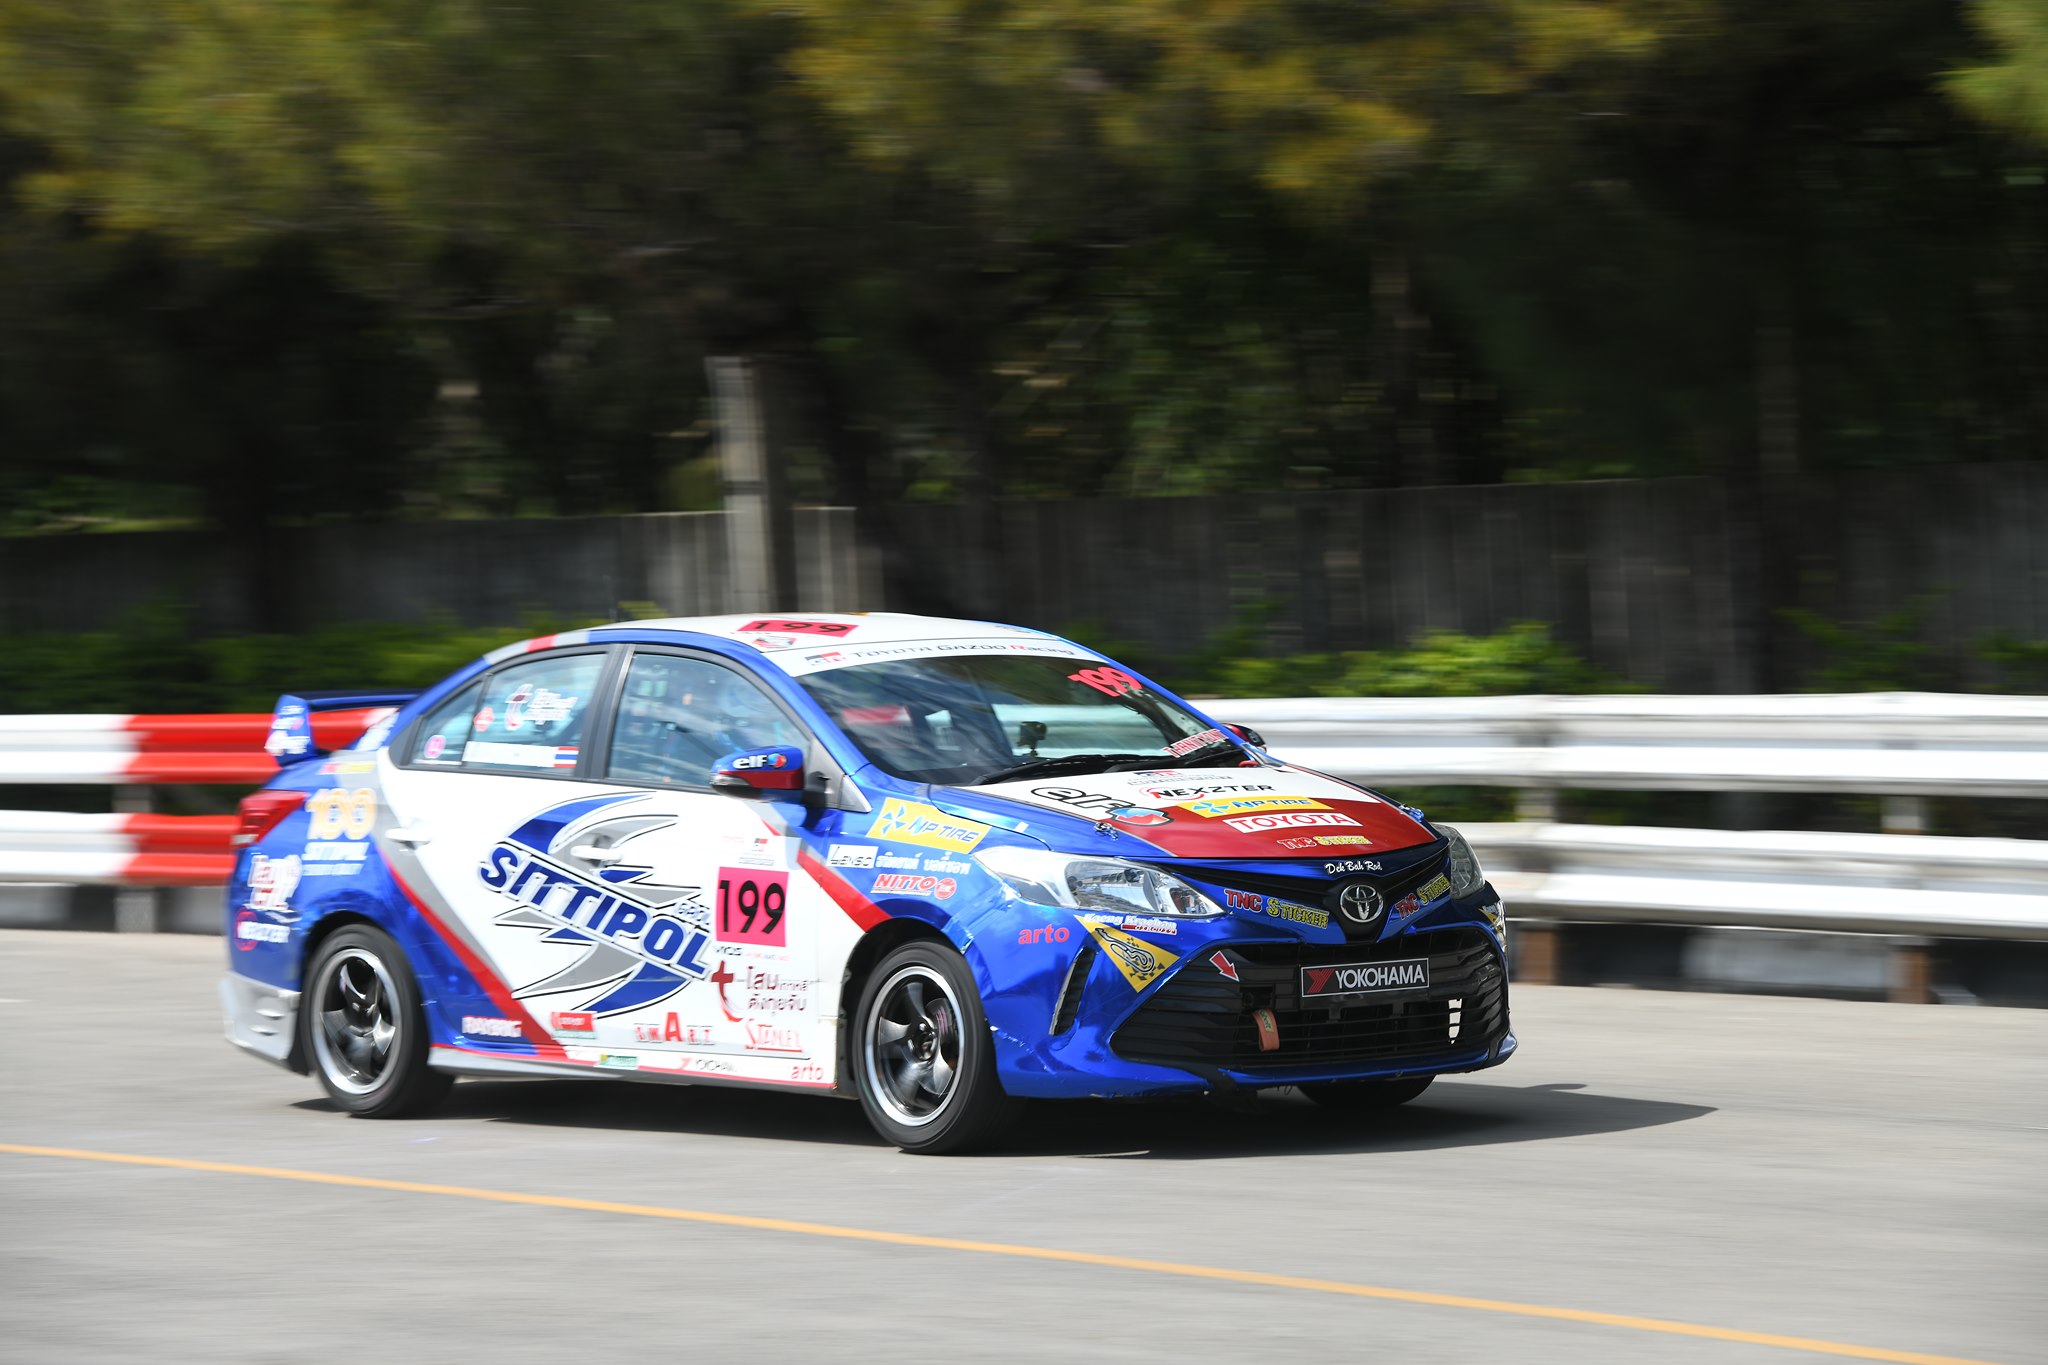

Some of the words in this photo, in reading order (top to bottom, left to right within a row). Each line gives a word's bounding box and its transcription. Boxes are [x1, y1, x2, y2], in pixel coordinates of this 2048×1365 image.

[753, 621, 849, 634] 199
[853, 645, 932, 659] TOYOTA
[937, 644, 1007, 652] GAZOO
[1010, 644, 1075, 657] Racing
[1067, 666, 1143, 697] 199
[732, 754, 768, 770] elf
[1031, 787, 1136, 809] elf
[1151, 784, 1275, 799] NEXZTER
[1231, 814, 1356, 830] TOYOTA
[939, 825, 980, 842] TIRE
[873, 873, 938, 890] NITTO
[479, 845, 710, 977] SITTIPOL
[719, 880, 786, 934] 199
[1224, 889, 1262, 912] TNC
[1267, 898, 1329, 929] STICKER
[1395, 893, 1420, 920] TNC
[1018, 923, 1070, 945] arto
[1335, 964, 1425, 989] YOKOHAMA
[791, 1062, 824, 1081] arto
